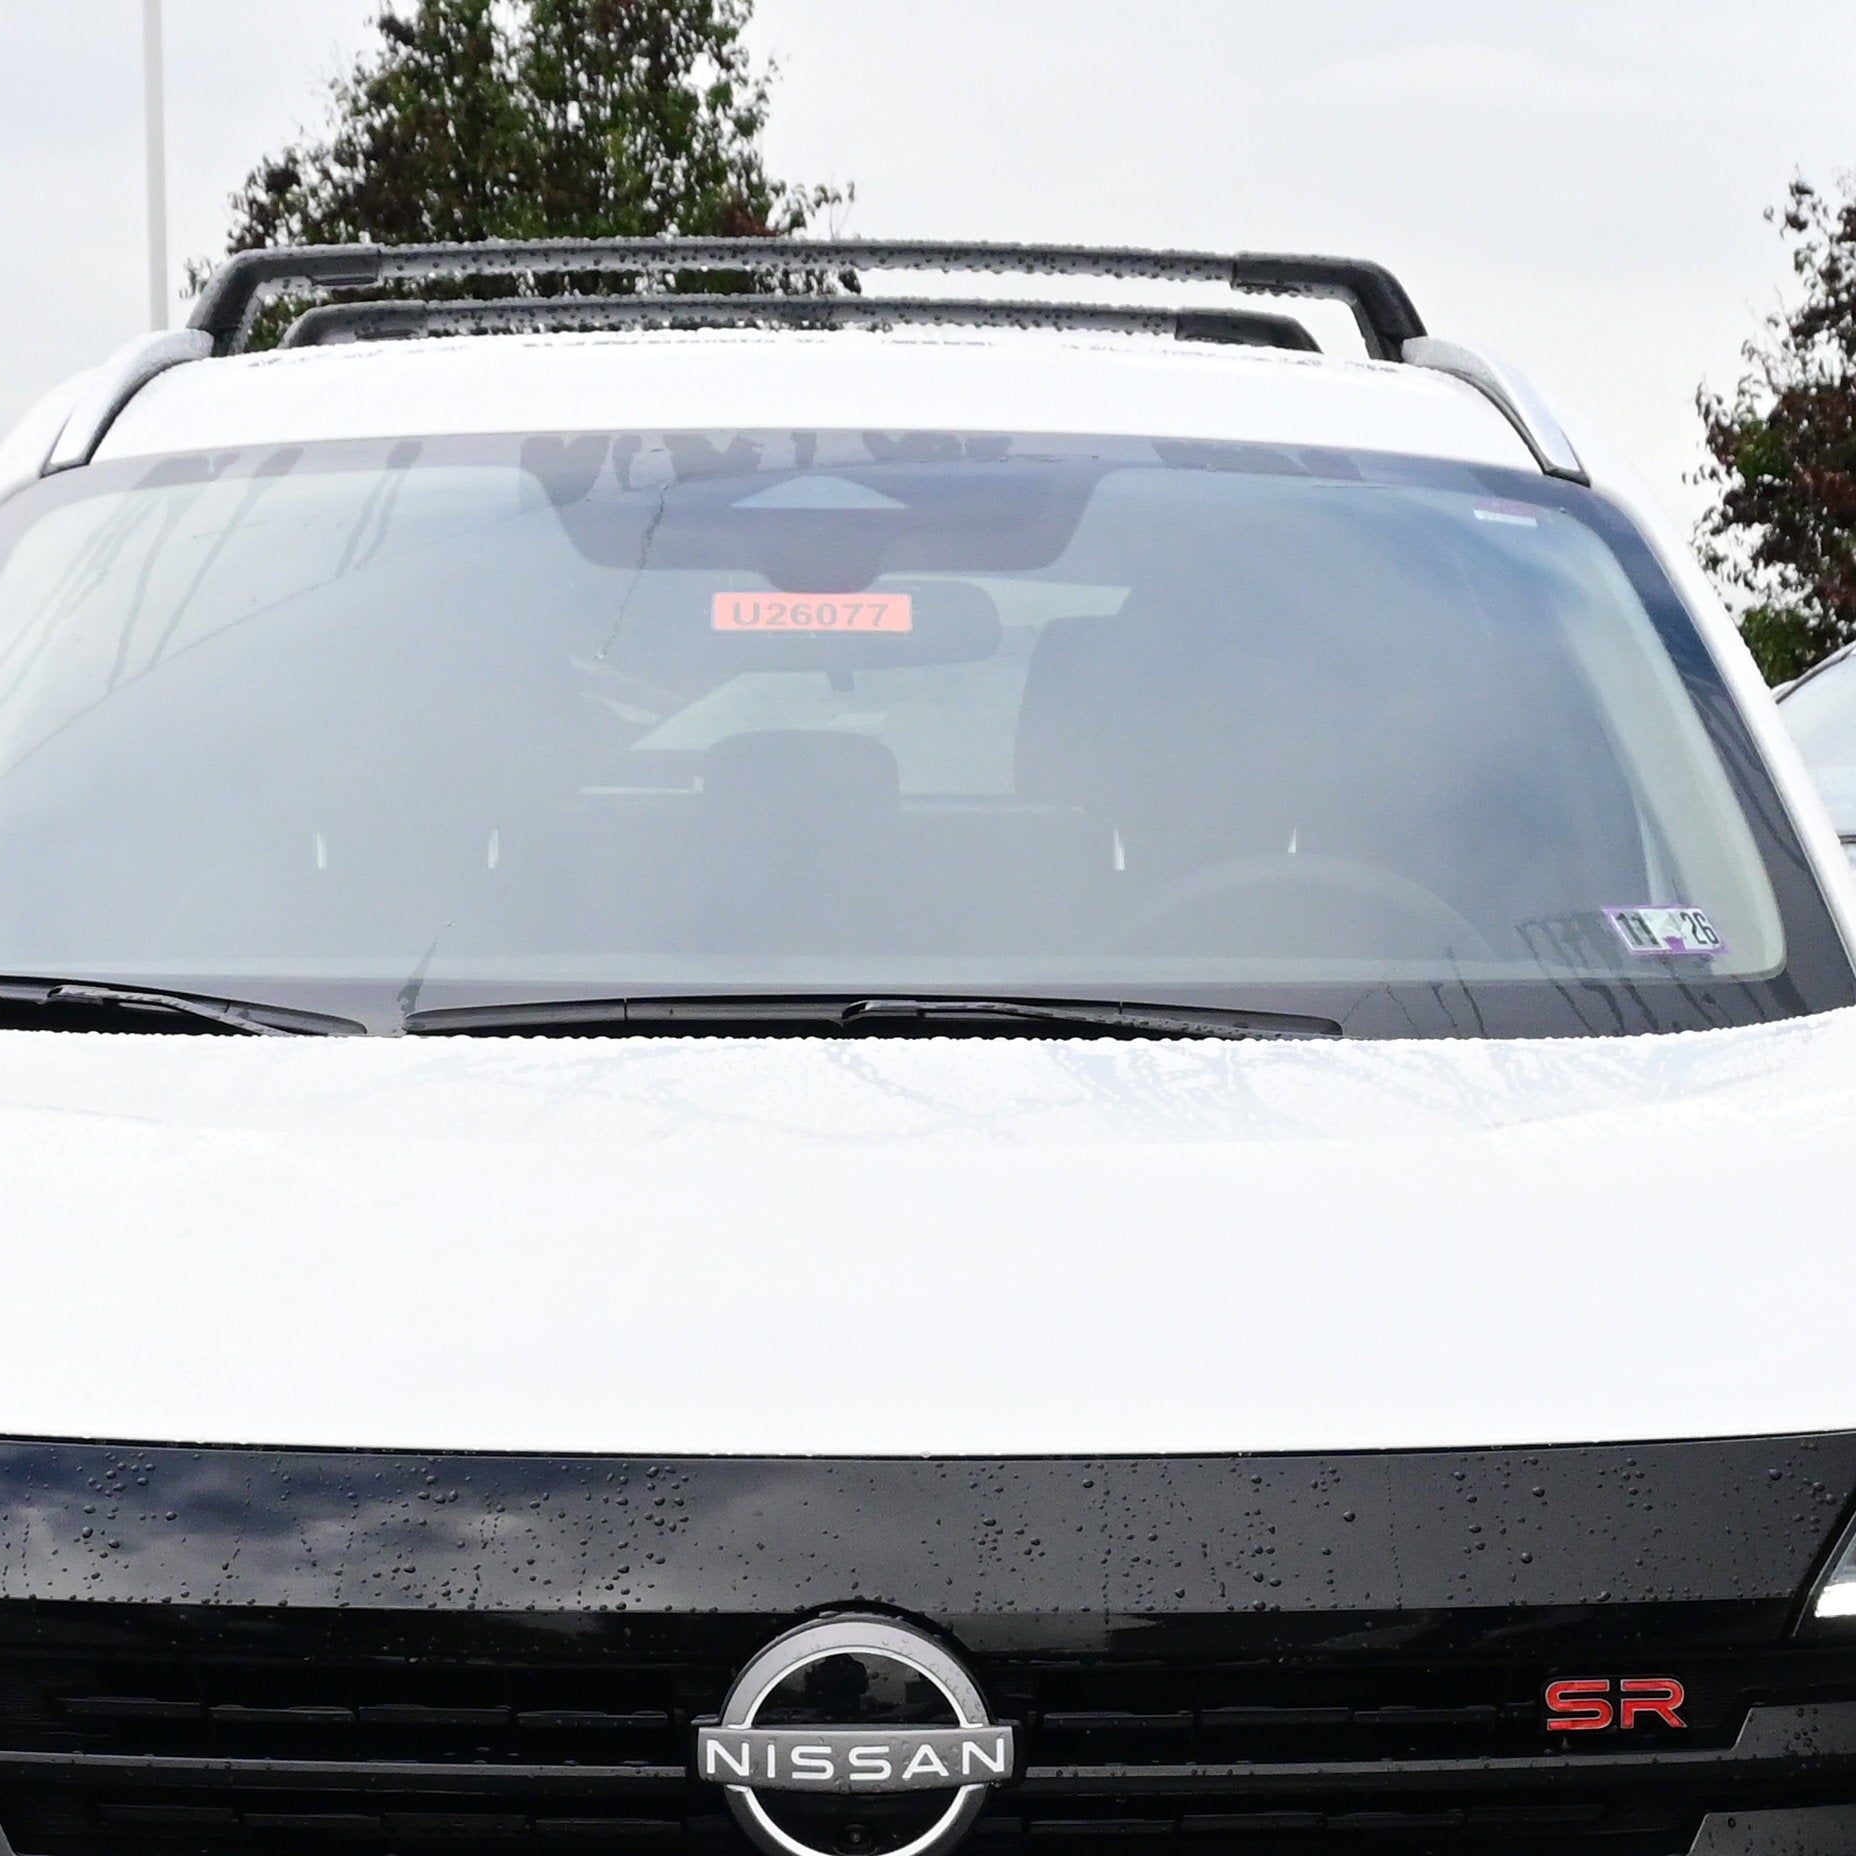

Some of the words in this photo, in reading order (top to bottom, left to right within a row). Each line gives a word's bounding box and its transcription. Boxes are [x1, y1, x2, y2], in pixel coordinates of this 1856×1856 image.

[733, 603, 888, 626] U26077
[1680, 912, 1720, 944] 26
[1546, 1679, 1687, 1730] SR
[706, 1739, 1005, 1780] NISSAN
